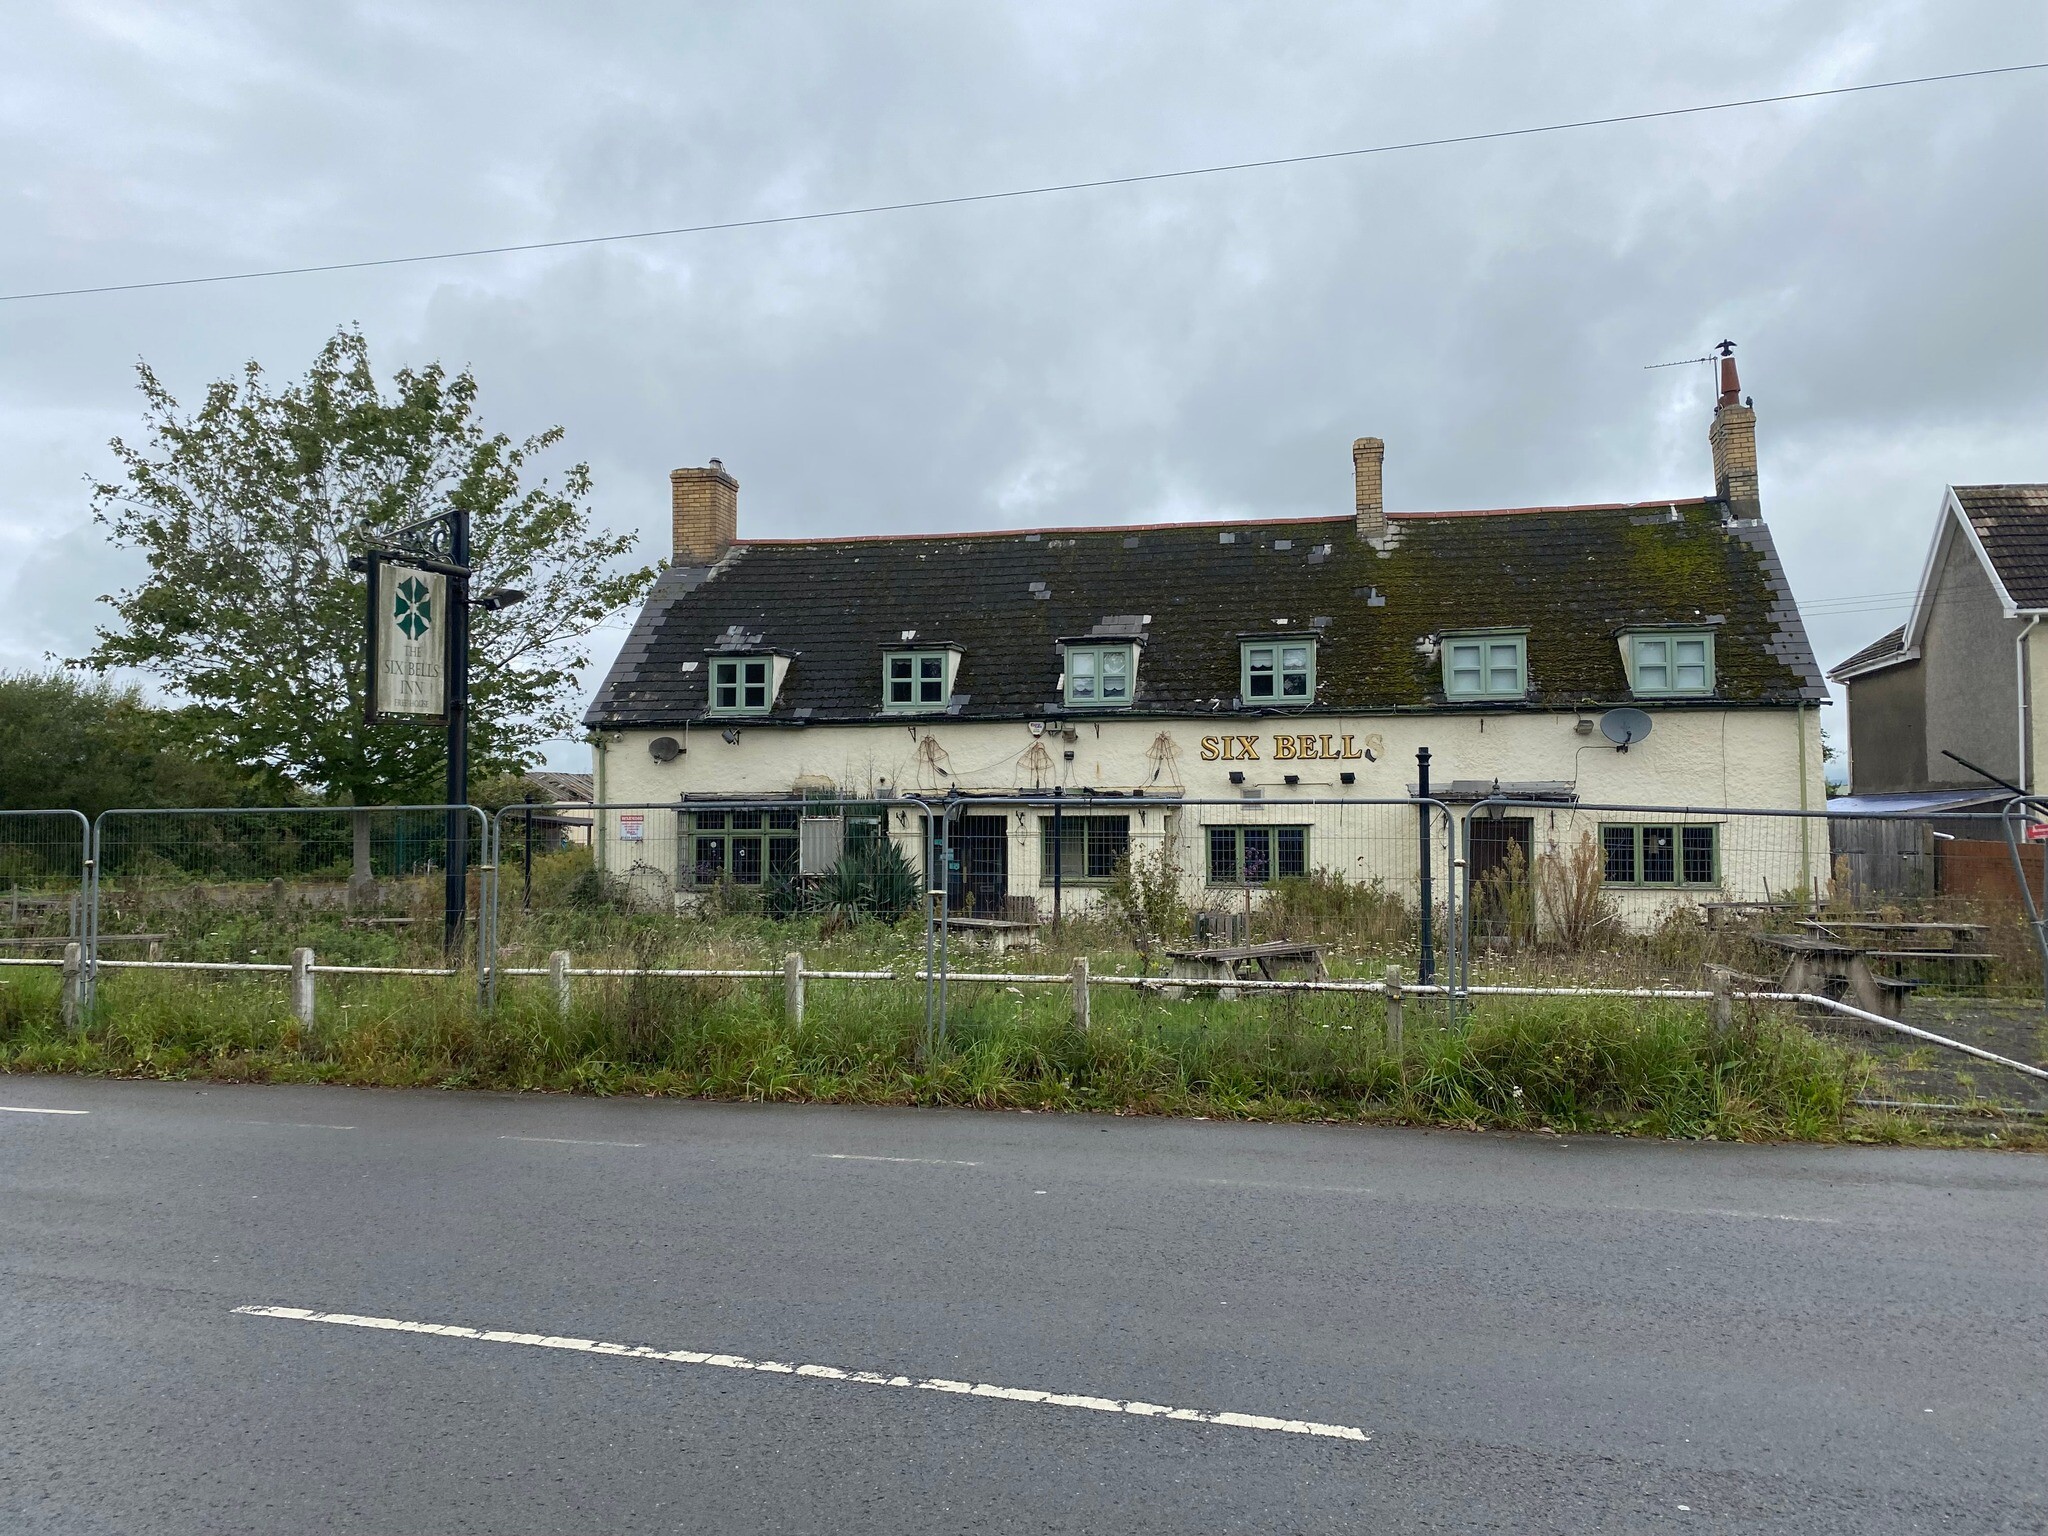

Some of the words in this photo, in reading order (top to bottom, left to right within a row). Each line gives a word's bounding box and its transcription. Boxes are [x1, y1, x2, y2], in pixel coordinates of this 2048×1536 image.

[403, 645, 422, 658] THE
[384, 659, 404, 675] SIX
[407, 661, 440, 678] BELLS
[400, 679, 426, 695] INN
[1200, 735, 1260, 761] SIX
[1273, 733, 1385, 762] BELLS
